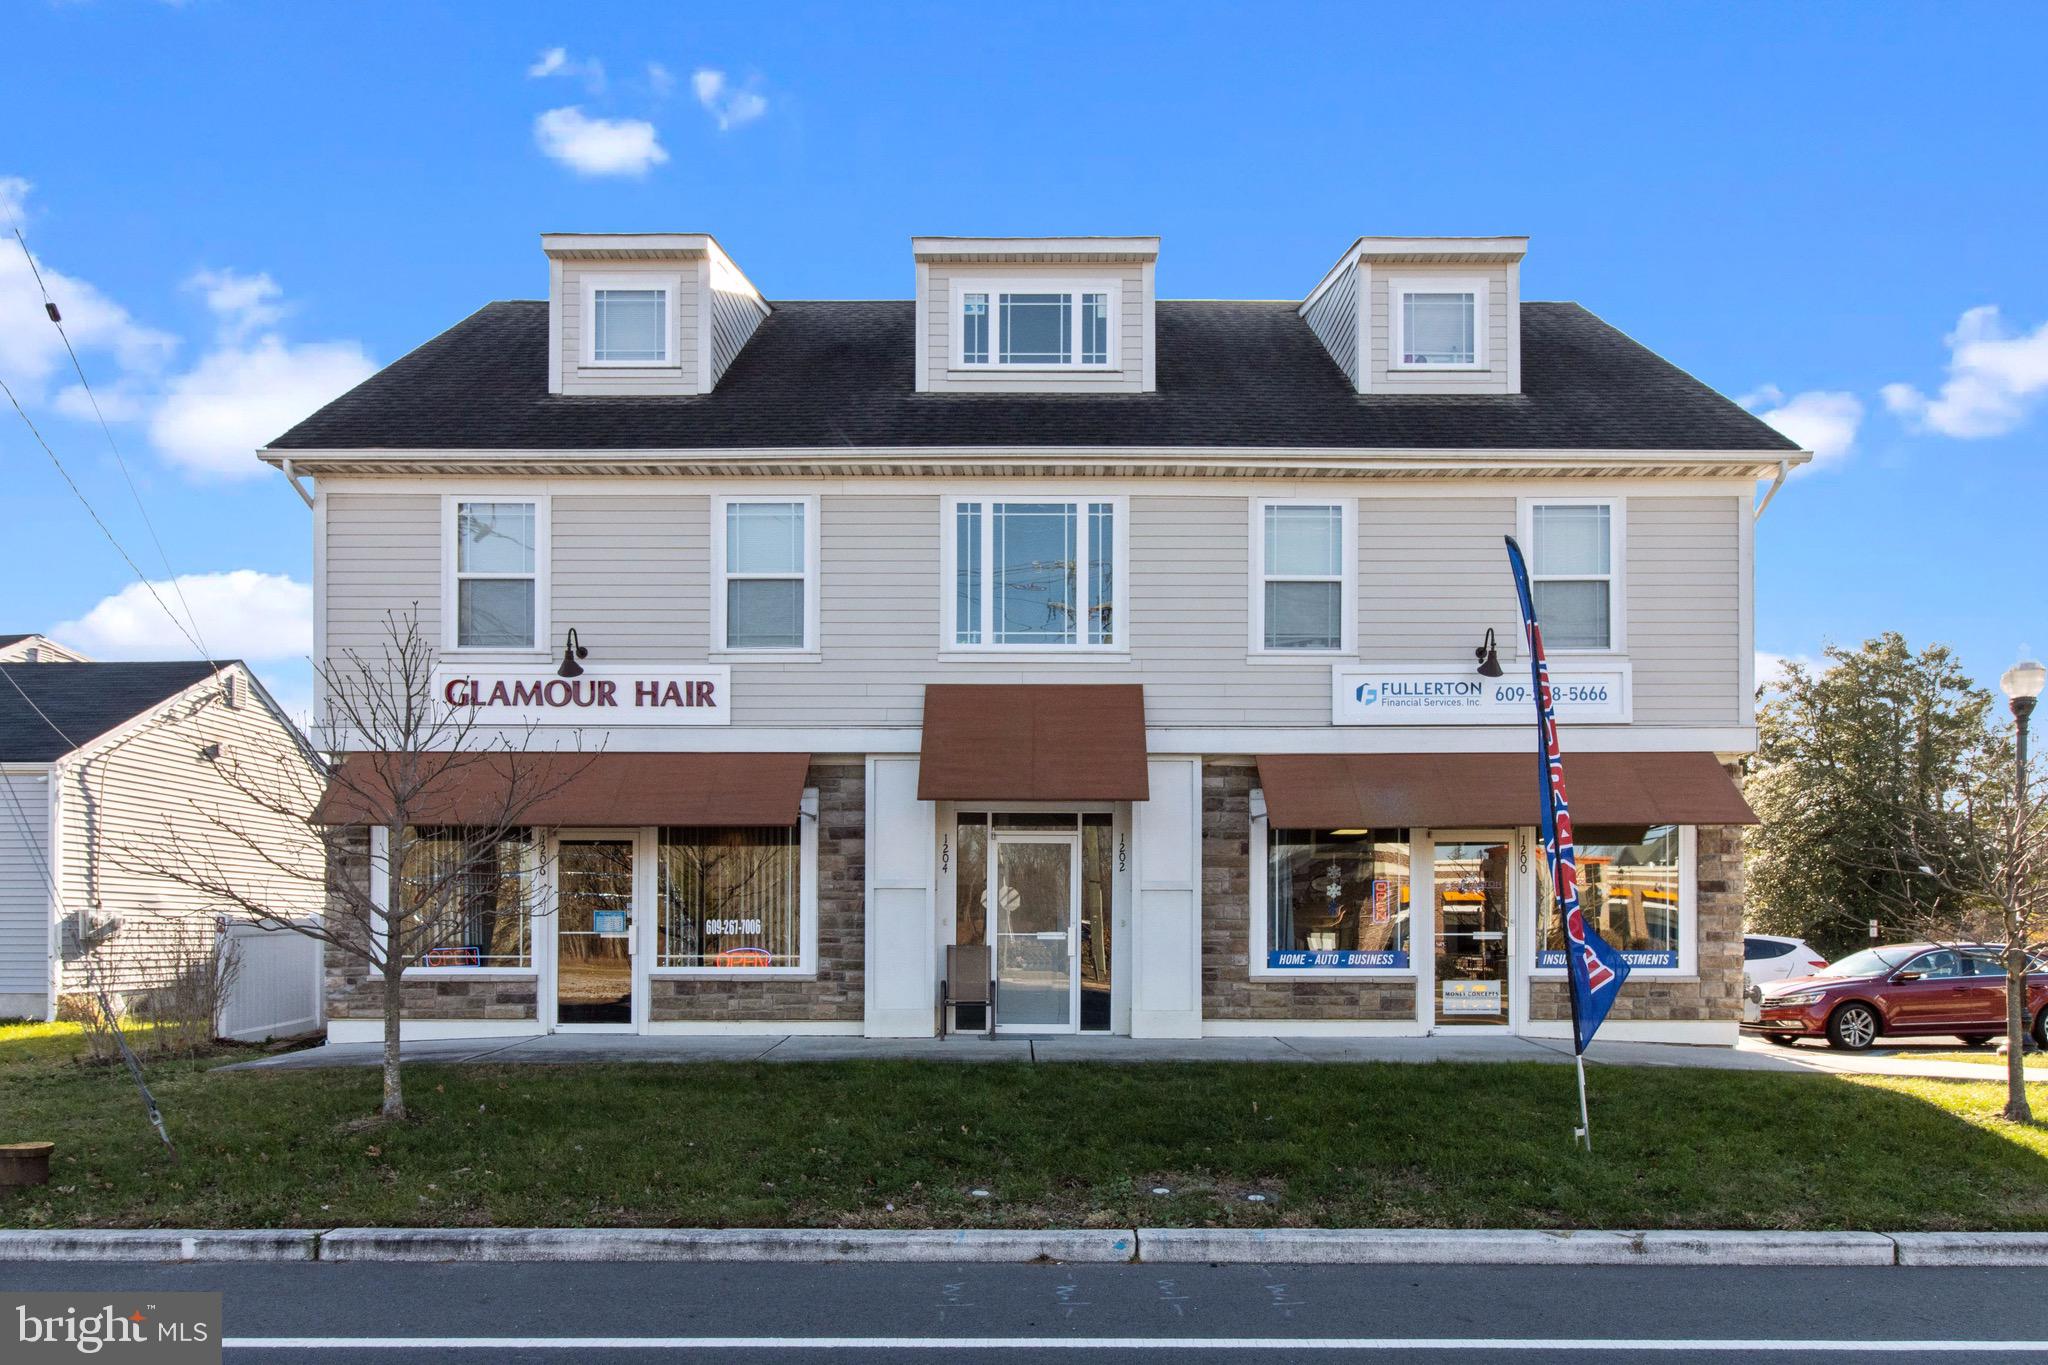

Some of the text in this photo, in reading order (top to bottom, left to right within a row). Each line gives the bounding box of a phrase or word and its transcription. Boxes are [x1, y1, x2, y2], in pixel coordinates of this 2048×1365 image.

[444, 679, 717, 708] GLAMOUR HAIR
[1382, 682, 1482, 696] FULLERTON
[1495, 686, 1608, 702] 609-8-5666
[1382, 698, 1421, 707] Financial
[1467, 698, 1482, 707] Inc.
[1375, 882, 1387, 921] OPEN
[706, 919, 761, 935] 609-267-7006
[429, 949, 477, 966] OPEN
[1279, 954, 1307, 965] HOME
[1314, 954, 1340, 965] AUTO
[1347, 954, 1395, 965] BUSINESS
